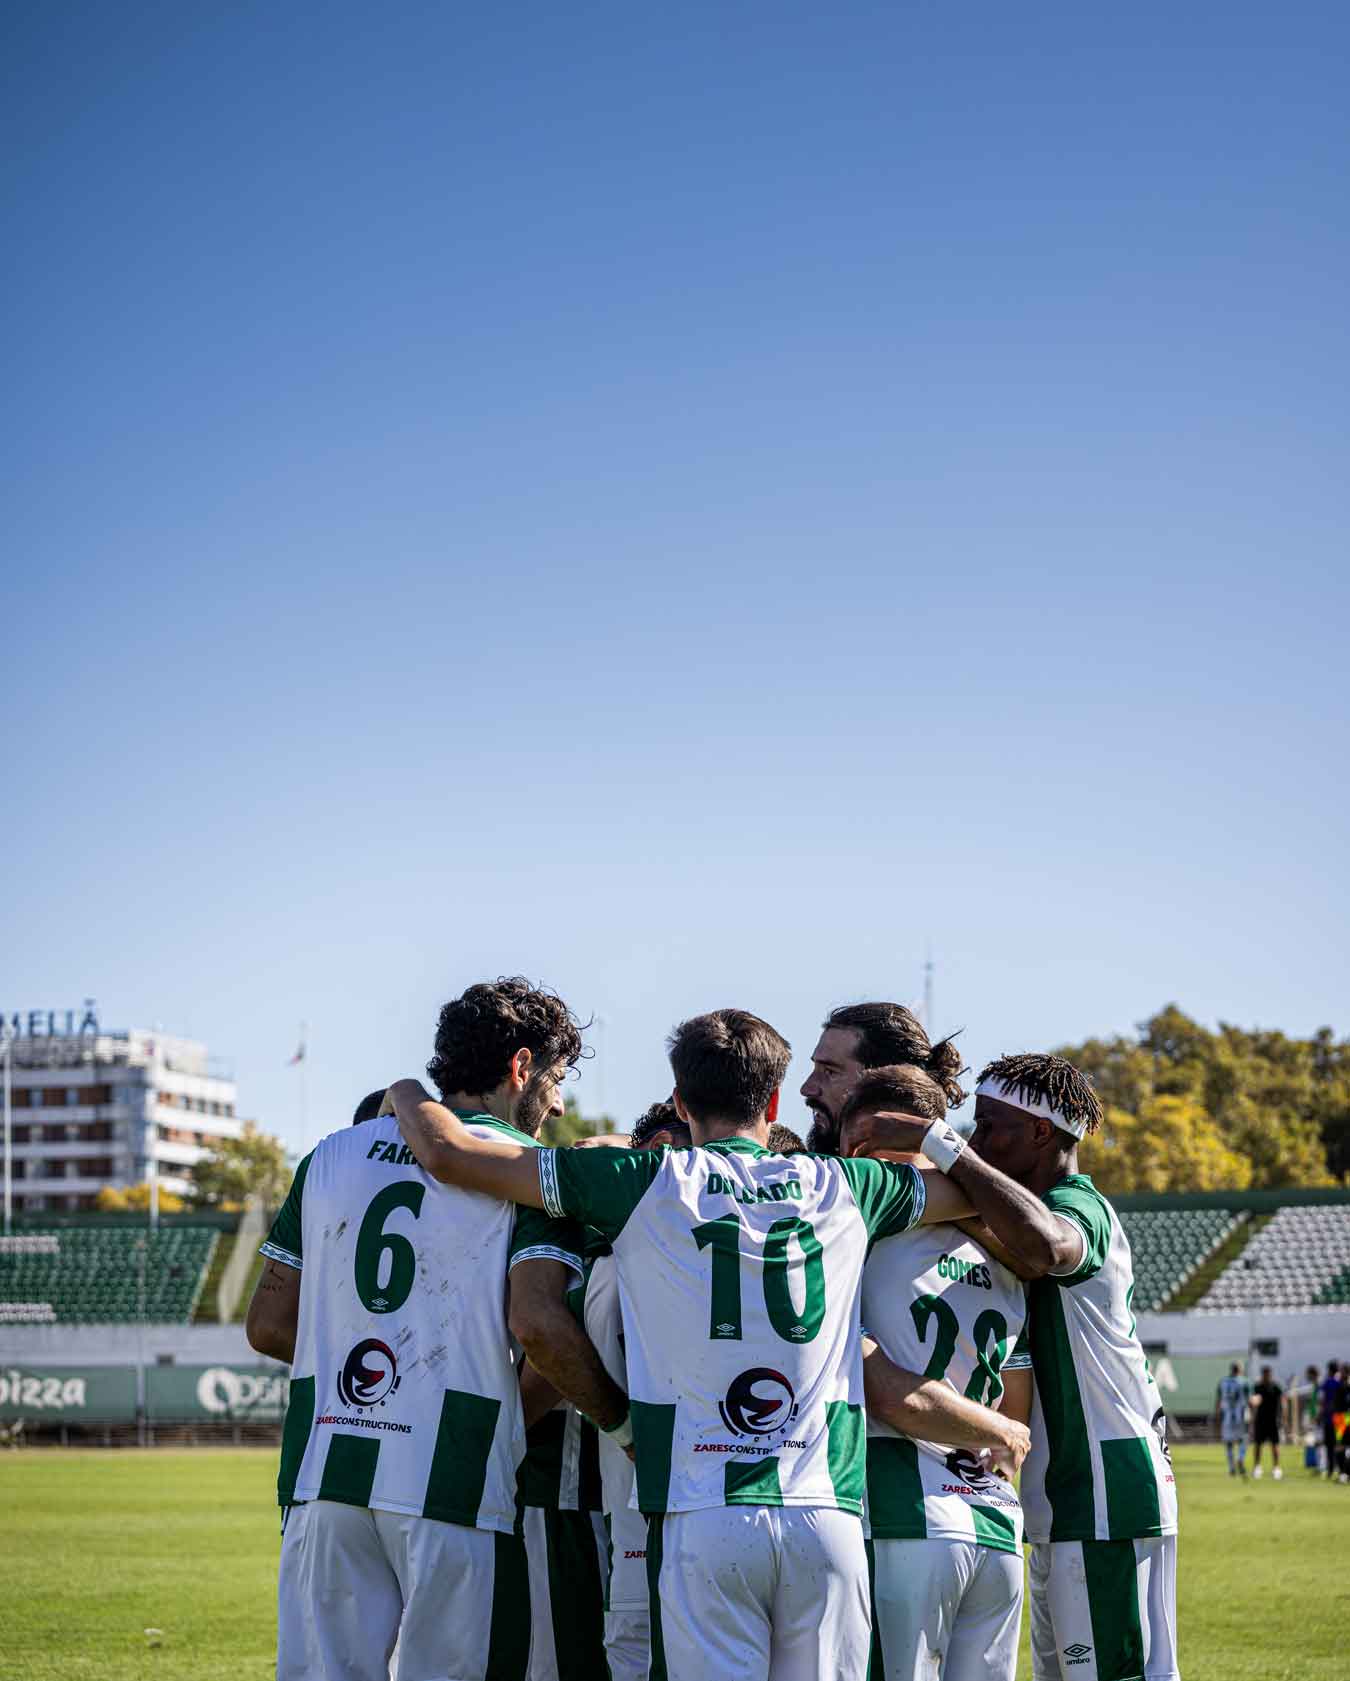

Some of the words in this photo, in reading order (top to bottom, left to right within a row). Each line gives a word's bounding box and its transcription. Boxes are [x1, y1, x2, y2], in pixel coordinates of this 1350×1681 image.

[355, 1181, 426, 1314] 6
[691, 1213, 826, 1344] 10
[938, 1254, 992, 1290] GOMES
[315, 1416, 412, 1434] ZARESCONSTRUCTIONS
[693, 1440, 807, 1456] ZARESCONSTRTIONS
[1065, 1657, 1090, 1666] umbro
